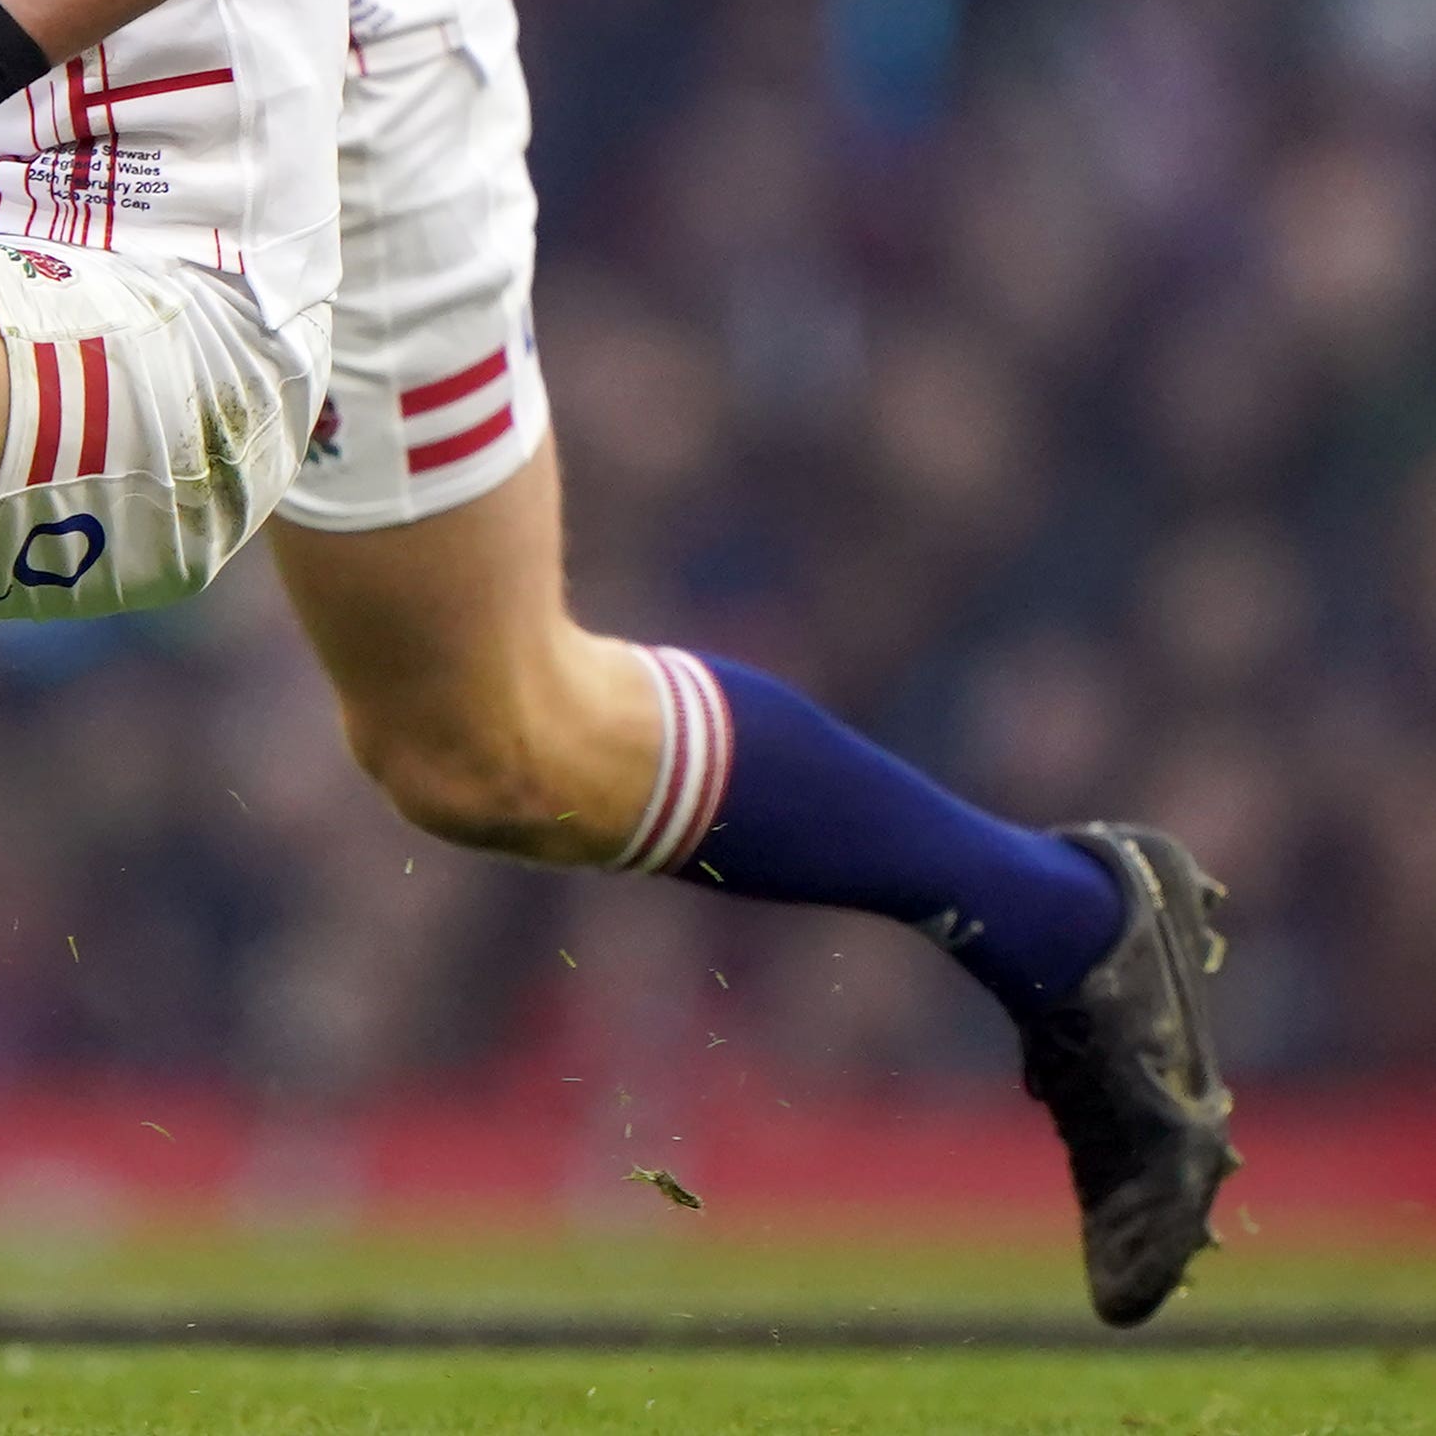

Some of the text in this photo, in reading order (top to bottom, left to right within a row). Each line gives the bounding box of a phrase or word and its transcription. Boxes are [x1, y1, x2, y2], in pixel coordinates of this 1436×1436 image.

[102, 145, 161, 161] Seward
[118, 162, 161, 176] Wales
[135, 181, 170, 194] 2023
[120, 198, 151, 211] Cap
